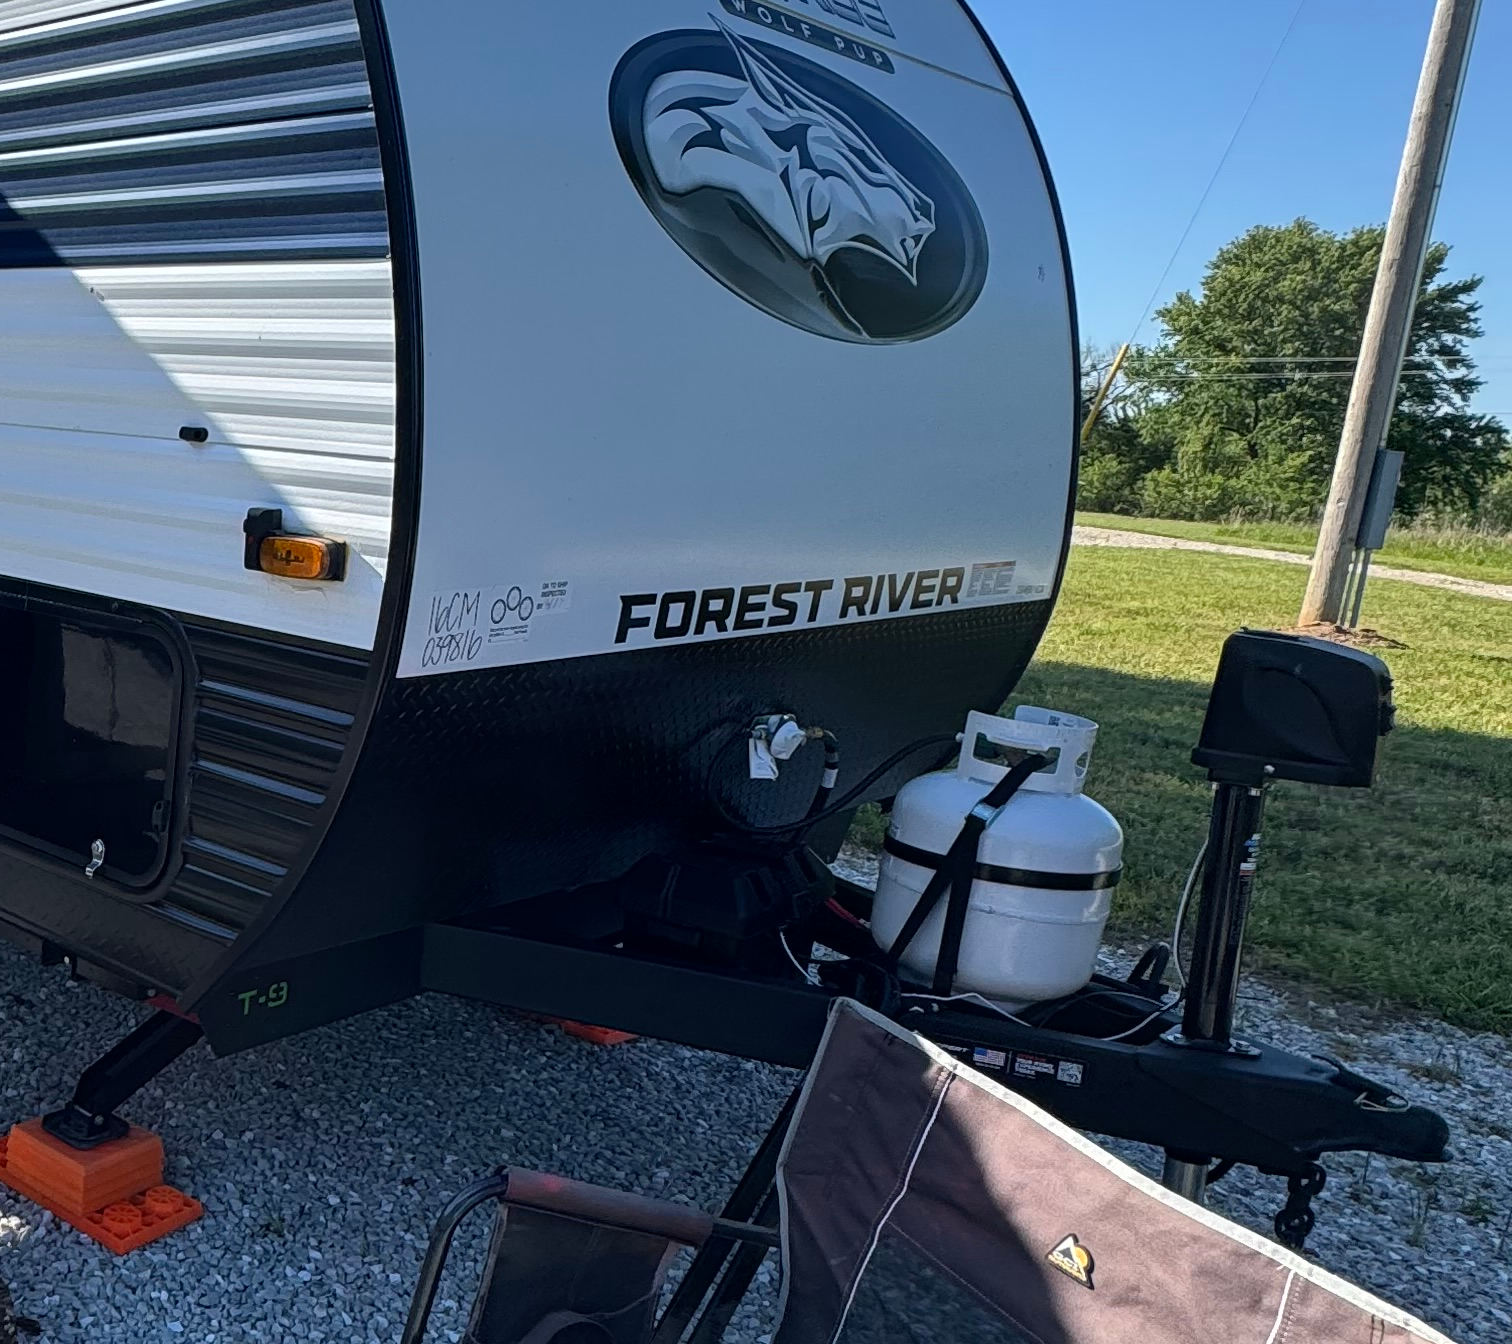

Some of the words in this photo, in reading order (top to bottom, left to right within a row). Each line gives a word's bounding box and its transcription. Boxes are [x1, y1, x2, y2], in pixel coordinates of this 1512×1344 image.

[833, 35, 883, 65] PUP
[614, 578, 835, 644] FOREST
[839, 567, 965, 618] RIVER
